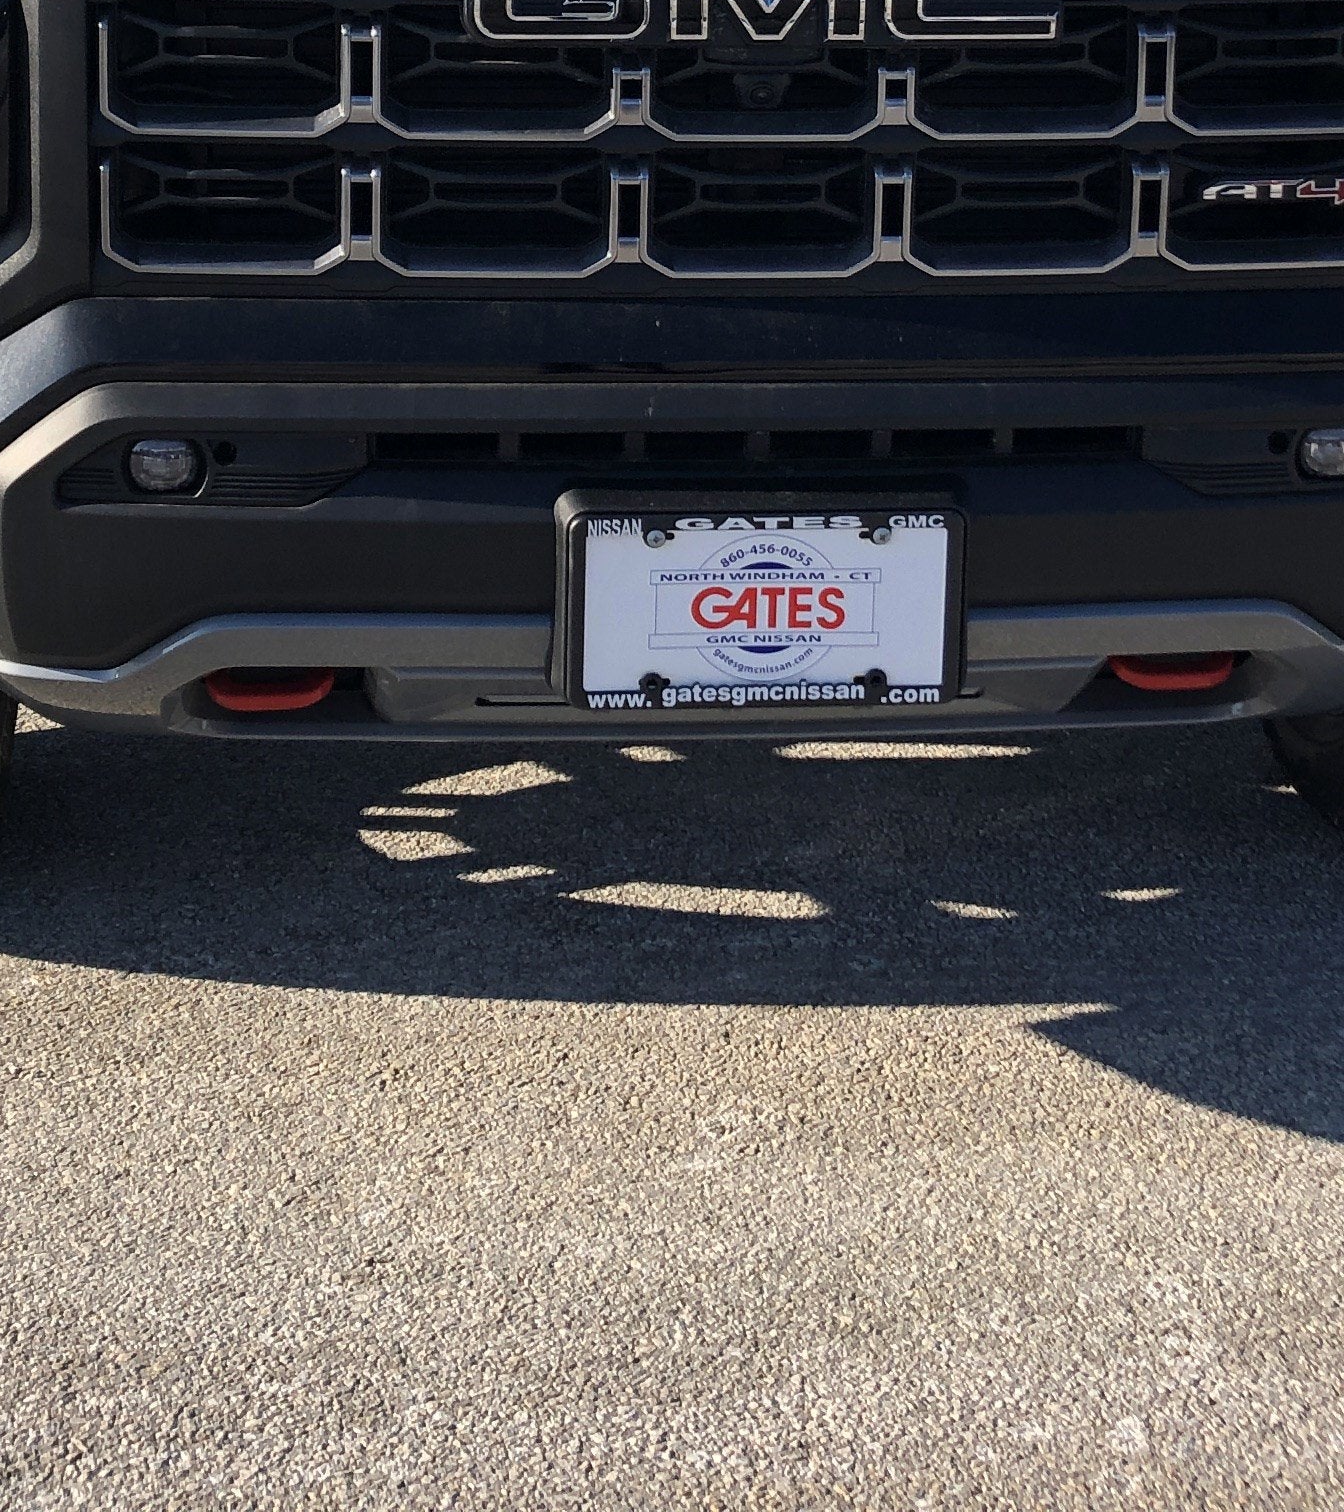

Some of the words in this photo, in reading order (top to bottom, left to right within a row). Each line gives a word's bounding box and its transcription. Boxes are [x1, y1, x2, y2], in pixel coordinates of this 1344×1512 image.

[587, 517, 643, 537] NISSAN
[674, 515, 863, 531] GATES
[888, 514, 945, 529] GMC
[719, 543, 814, 569] 860-456-0055
[659, 571, 725, 582] NORTH
[729, 570, 825, 582] WINDHAM
[848, 571, 872, 581] CT
[690, 586, 846, 630] GATES
[706, 634, 749, 644] GMC
[753, 633, 822, 644] NISSAN
[712, 647, 814, 676] gatesgmcnissan.com
[661, 679, 865, 707] gatesgmcnissan
